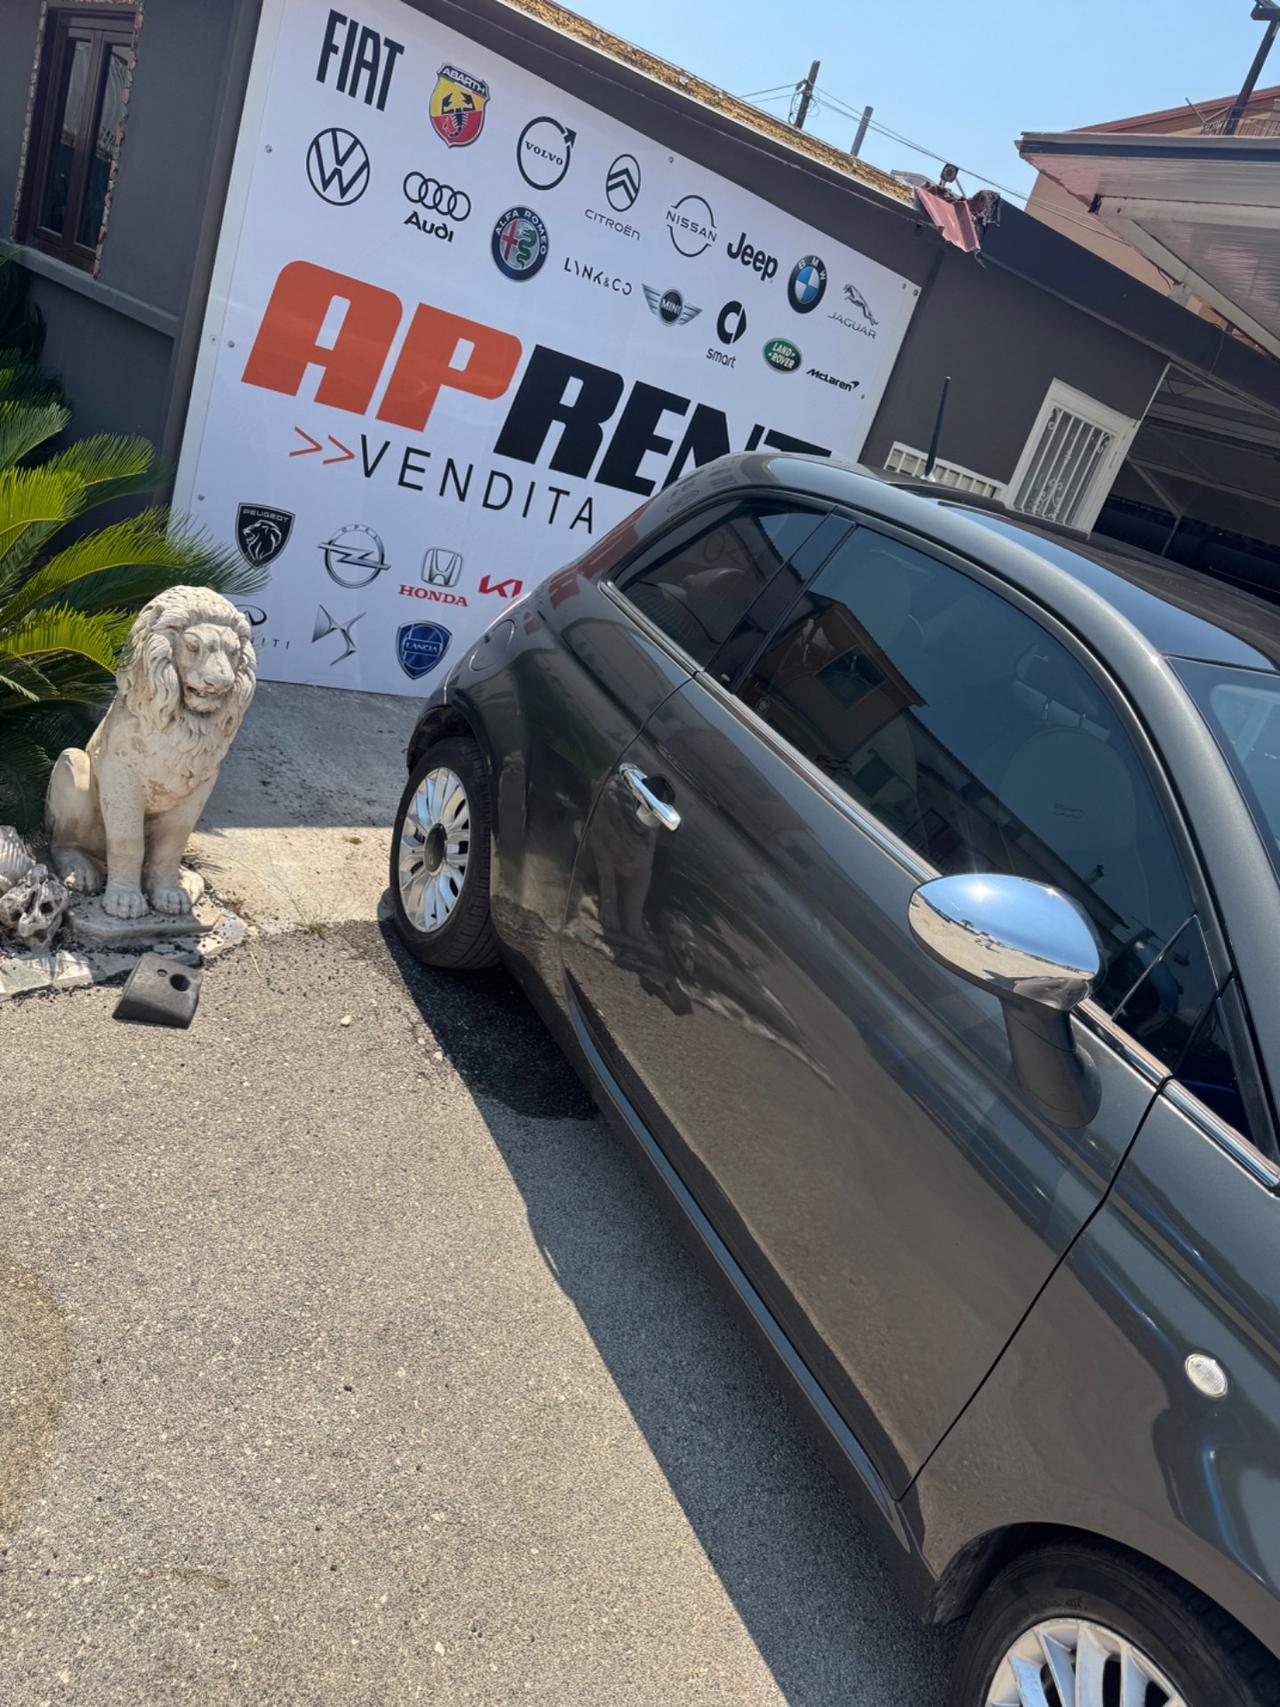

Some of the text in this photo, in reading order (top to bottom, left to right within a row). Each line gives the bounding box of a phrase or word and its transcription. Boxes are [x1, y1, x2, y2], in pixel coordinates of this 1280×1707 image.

[316, 9, 405, 112] FIAT
[442, 68, 486, 95] ABARTH
[525, 140, 564, 166] VOLVO
[404, 210, 455, 243] Audi
[495, 209, 547, 255] ALFA ROMEO
[665, 210, 718, 243] NISSAN
[727, 232, 779, 282] Jeep
[798, 257, 827, 281] BMW
[661, 298, 682, 316] MINI
[827, 311, 878, 339] JAGUAR
[706, 348, 737, 369] smart
[769, 352, 796, 369] ROVER
[771, 342, 793, 357] LAND
[806, 368, 853, 392] McLaren
[361, 434, 594, 535] VENDITA
[243, 508, 289, 522] PEUGEOT
[398, 584, 469, 607] HONDA
[406, 641, 439, 652] LANCIA
